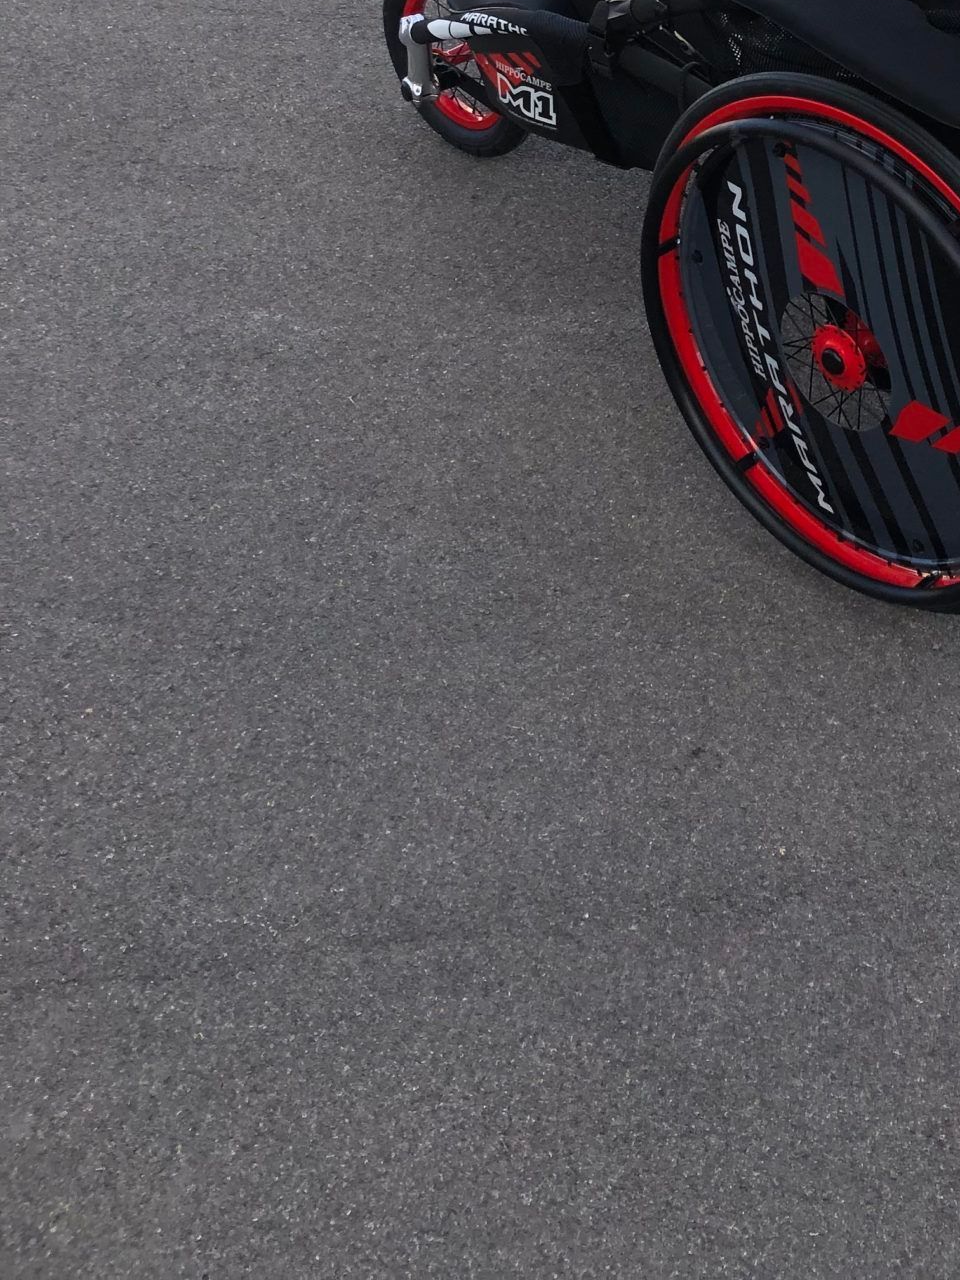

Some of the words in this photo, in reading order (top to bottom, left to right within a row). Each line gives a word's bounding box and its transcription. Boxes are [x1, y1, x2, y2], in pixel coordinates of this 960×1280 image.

[495, 61, 553, 92] HIPPOCAMPE
[497, 71, 557, 126] M1
[716, 218, 768, 381] HIPPOCAMPE
[727, 180, 835, 515] MARATHON
